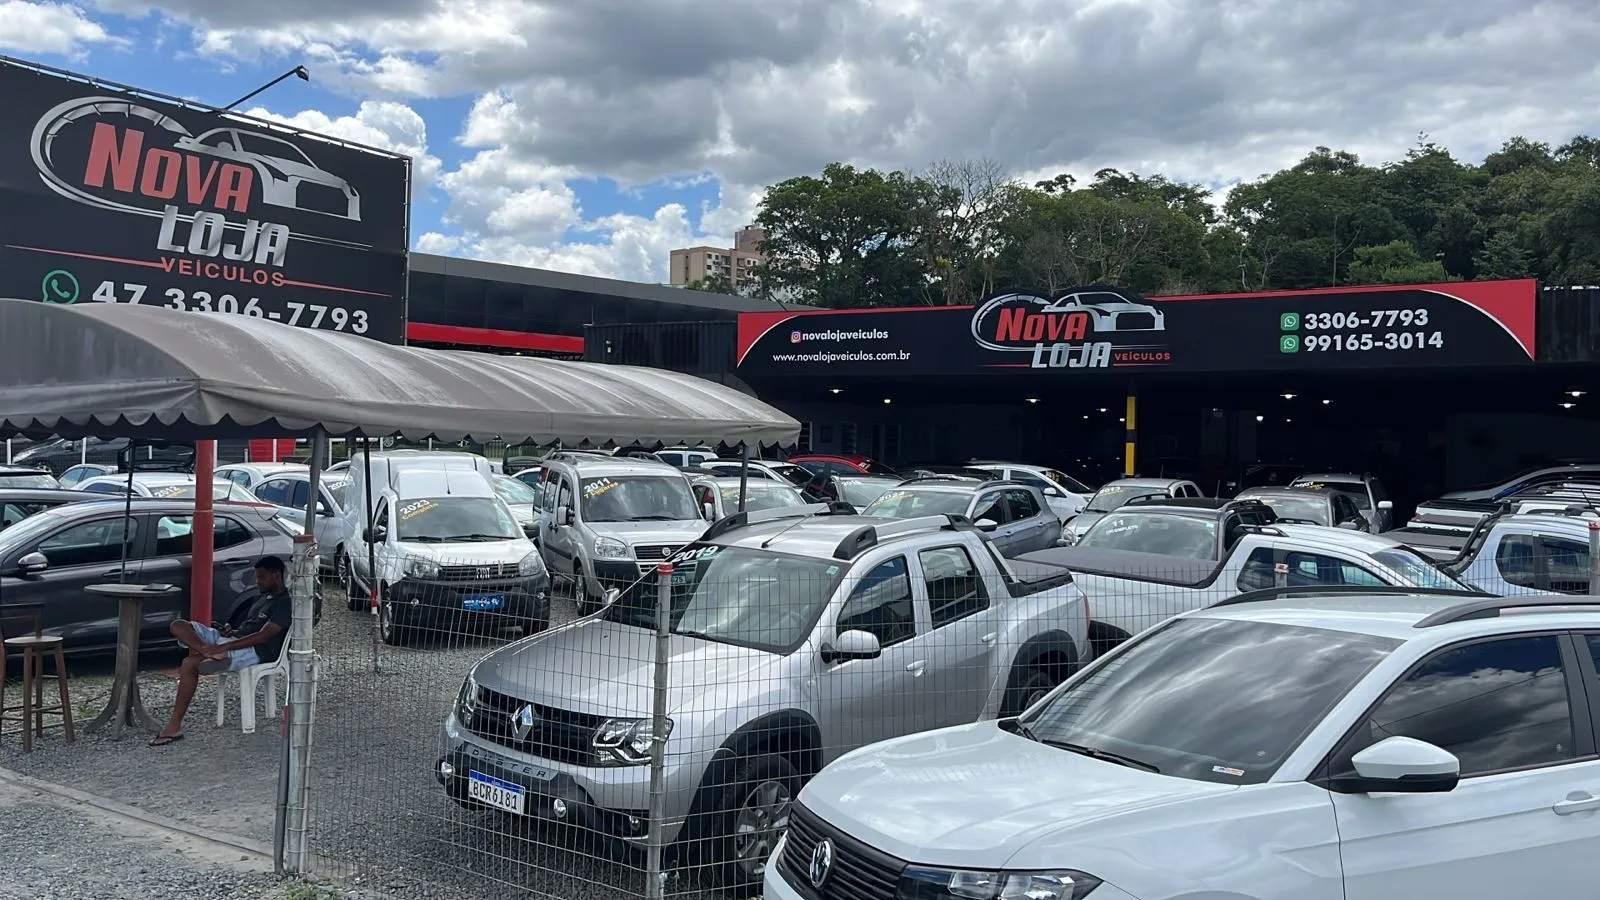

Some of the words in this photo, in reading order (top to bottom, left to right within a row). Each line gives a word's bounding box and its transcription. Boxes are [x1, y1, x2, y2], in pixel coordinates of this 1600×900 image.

[157, 205, 290, 267] LOJA
[161, 256, 285, 287] VEÍCULOS
[92, 280, 148, 304] 47
[164, 288, 369, 333] 3306-7793
[1304, 309, 1428, 328] 3306-7793
[802, 328, 889, 342] novalojaveiculos
[1304, 332, 1444, 351] 99165-3014
[772, 349, 911, 363] www.novalojaveiculos.com.br
[1031, 342, 1112, 368] LOJA
[1114, 351, 1171, 362] VEÍCULOS
[583, 477, 611, 493] 2011
[399, 499, 430, 515] 2023
[671, 545, 719, 563] 2019
[476, 567, 491, 579] FIAT
[473, 781, 517, 810] BCR6181
